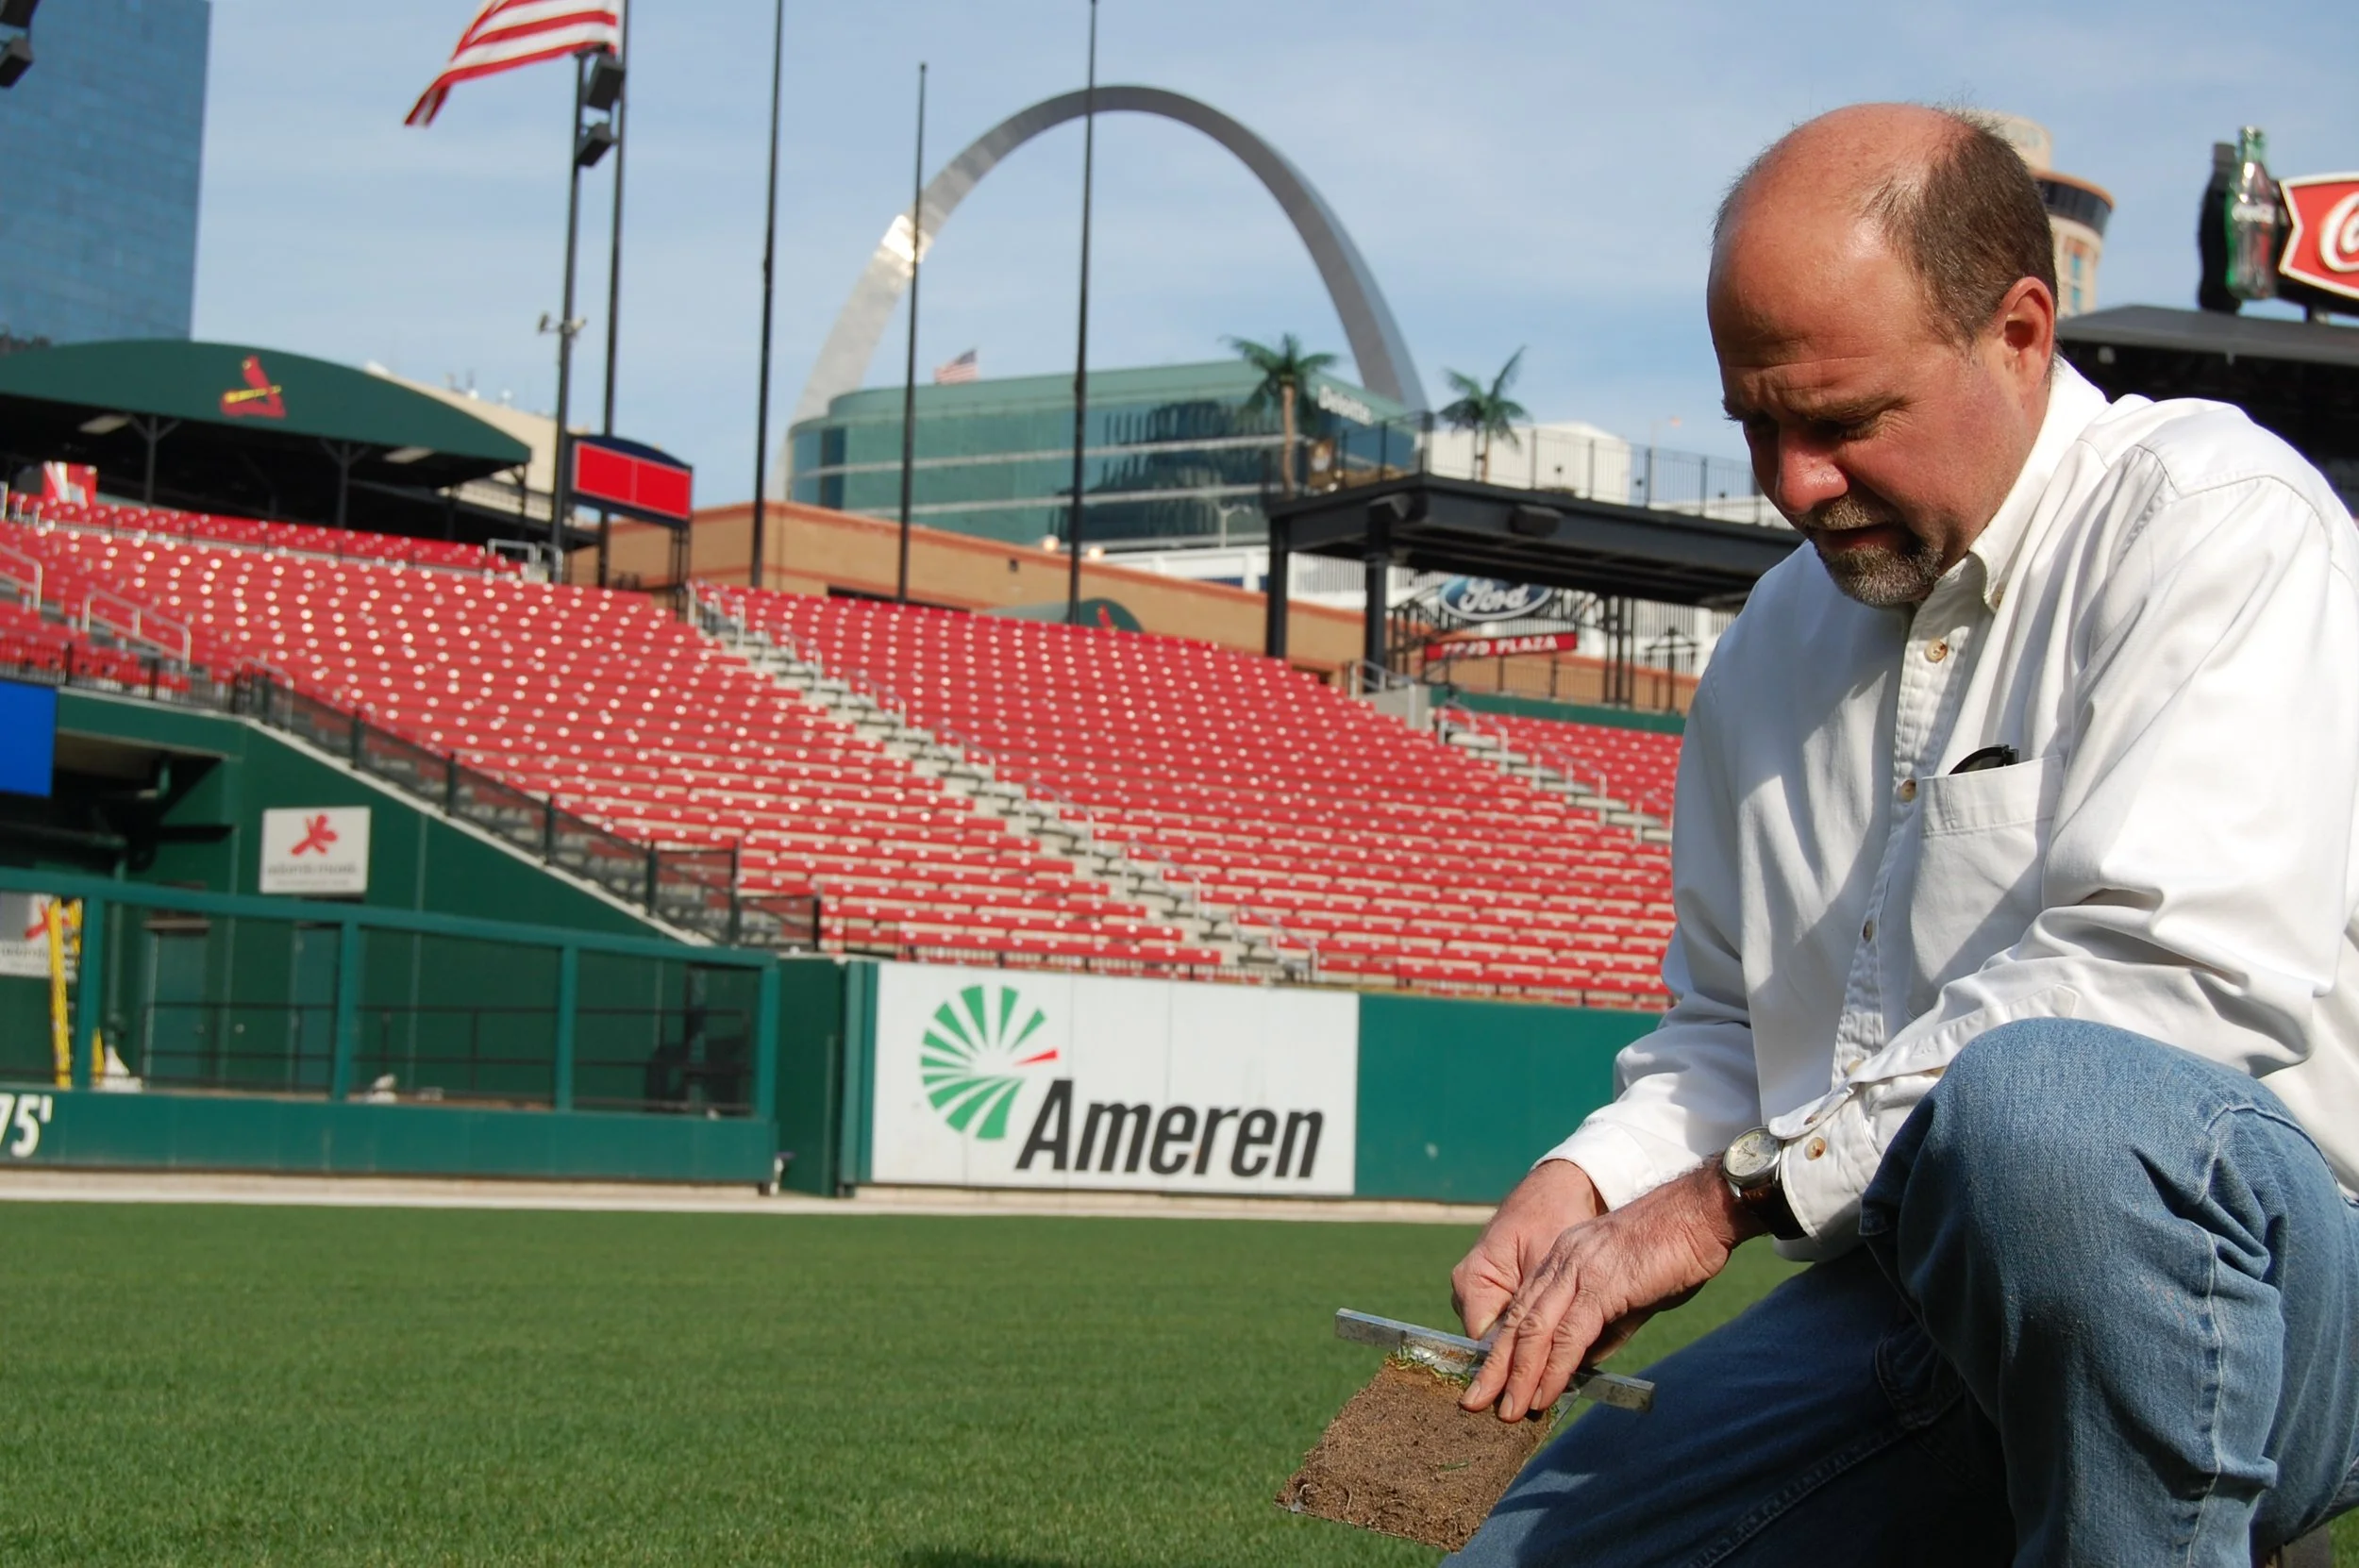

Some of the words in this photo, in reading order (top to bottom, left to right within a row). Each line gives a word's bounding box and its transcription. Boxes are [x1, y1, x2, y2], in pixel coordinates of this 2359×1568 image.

[1458, 577, 1530, 611] Ford
[1496, 636, 1558, 654] PLAZA
[1014, 1078, 1324, 1178] Ameren
